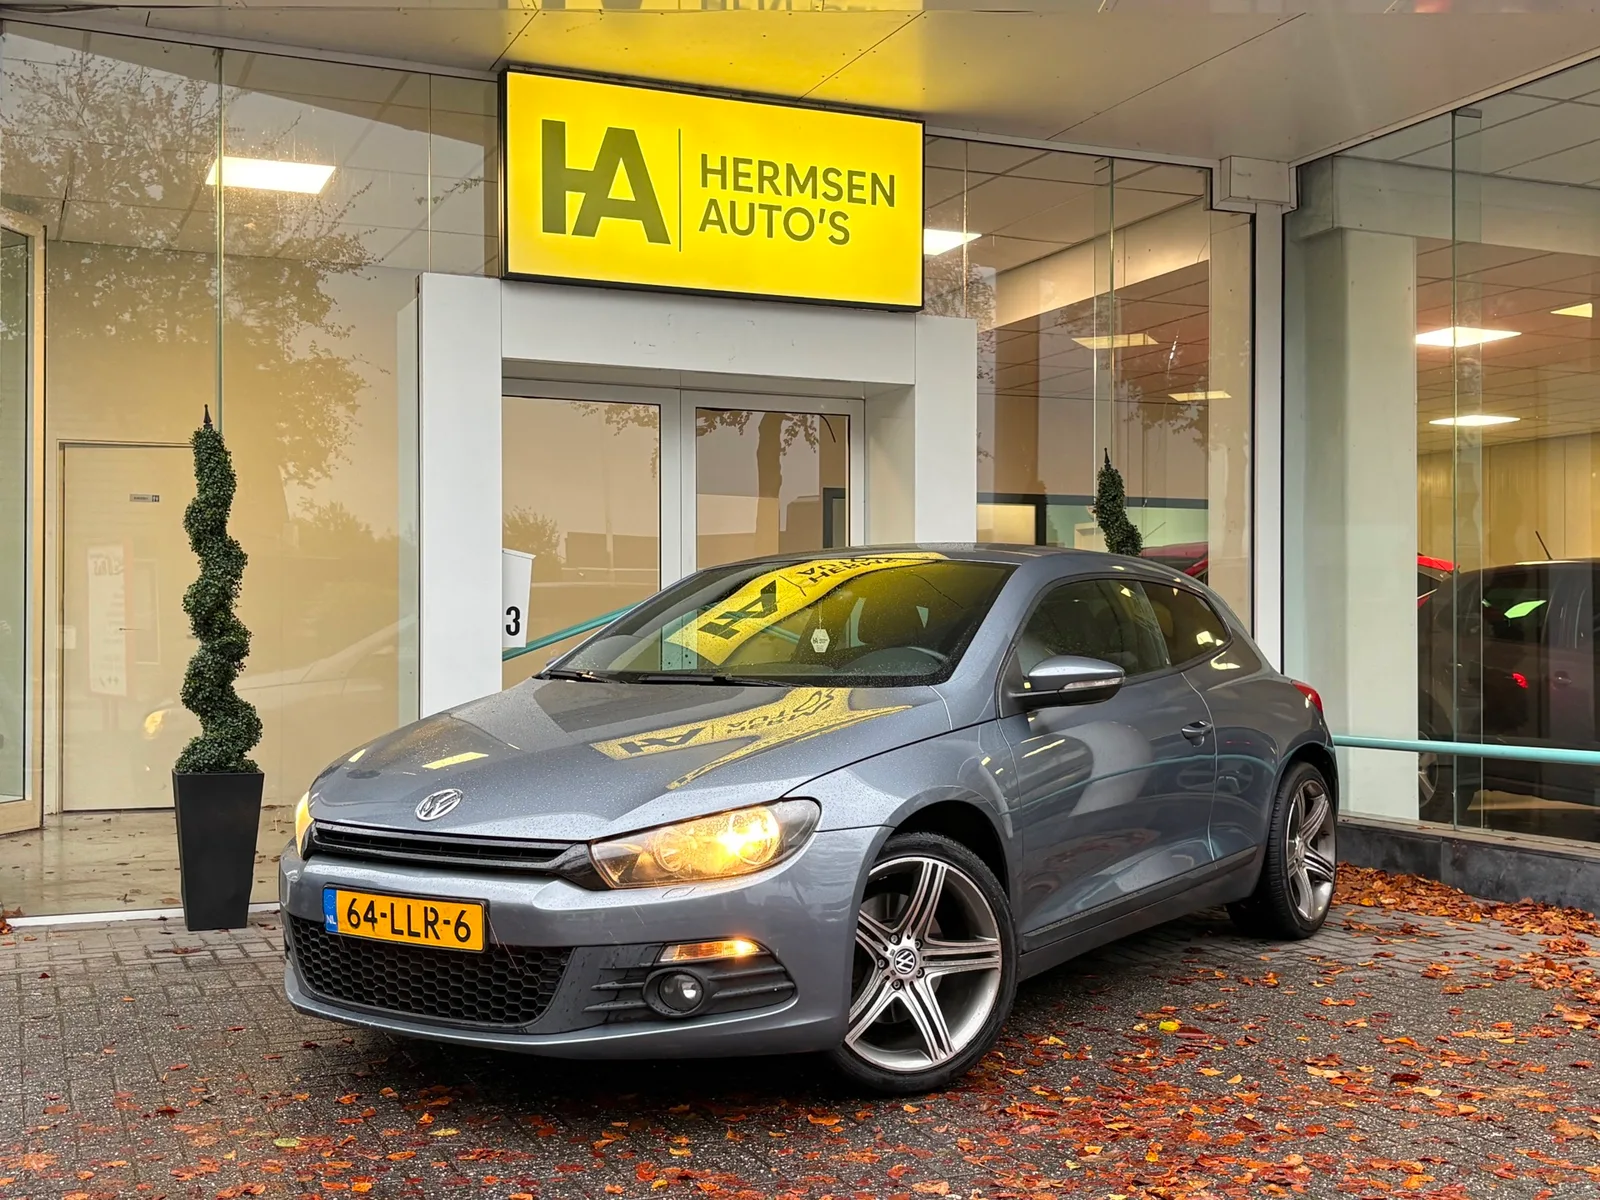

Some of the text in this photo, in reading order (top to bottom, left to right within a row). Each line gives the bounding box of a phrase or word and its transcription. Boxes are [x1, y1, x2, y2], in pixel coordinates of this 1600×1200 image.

[541, 118, 671, 245] HA
[701, 153, 895, 208] HERMSEN
[699, 198, 850, 246] AUTO'S
[505, 605, 521, 637] 3
[326, 913, 337, 926] NL
[347, 897, 472, 943] 64-LLR-6
